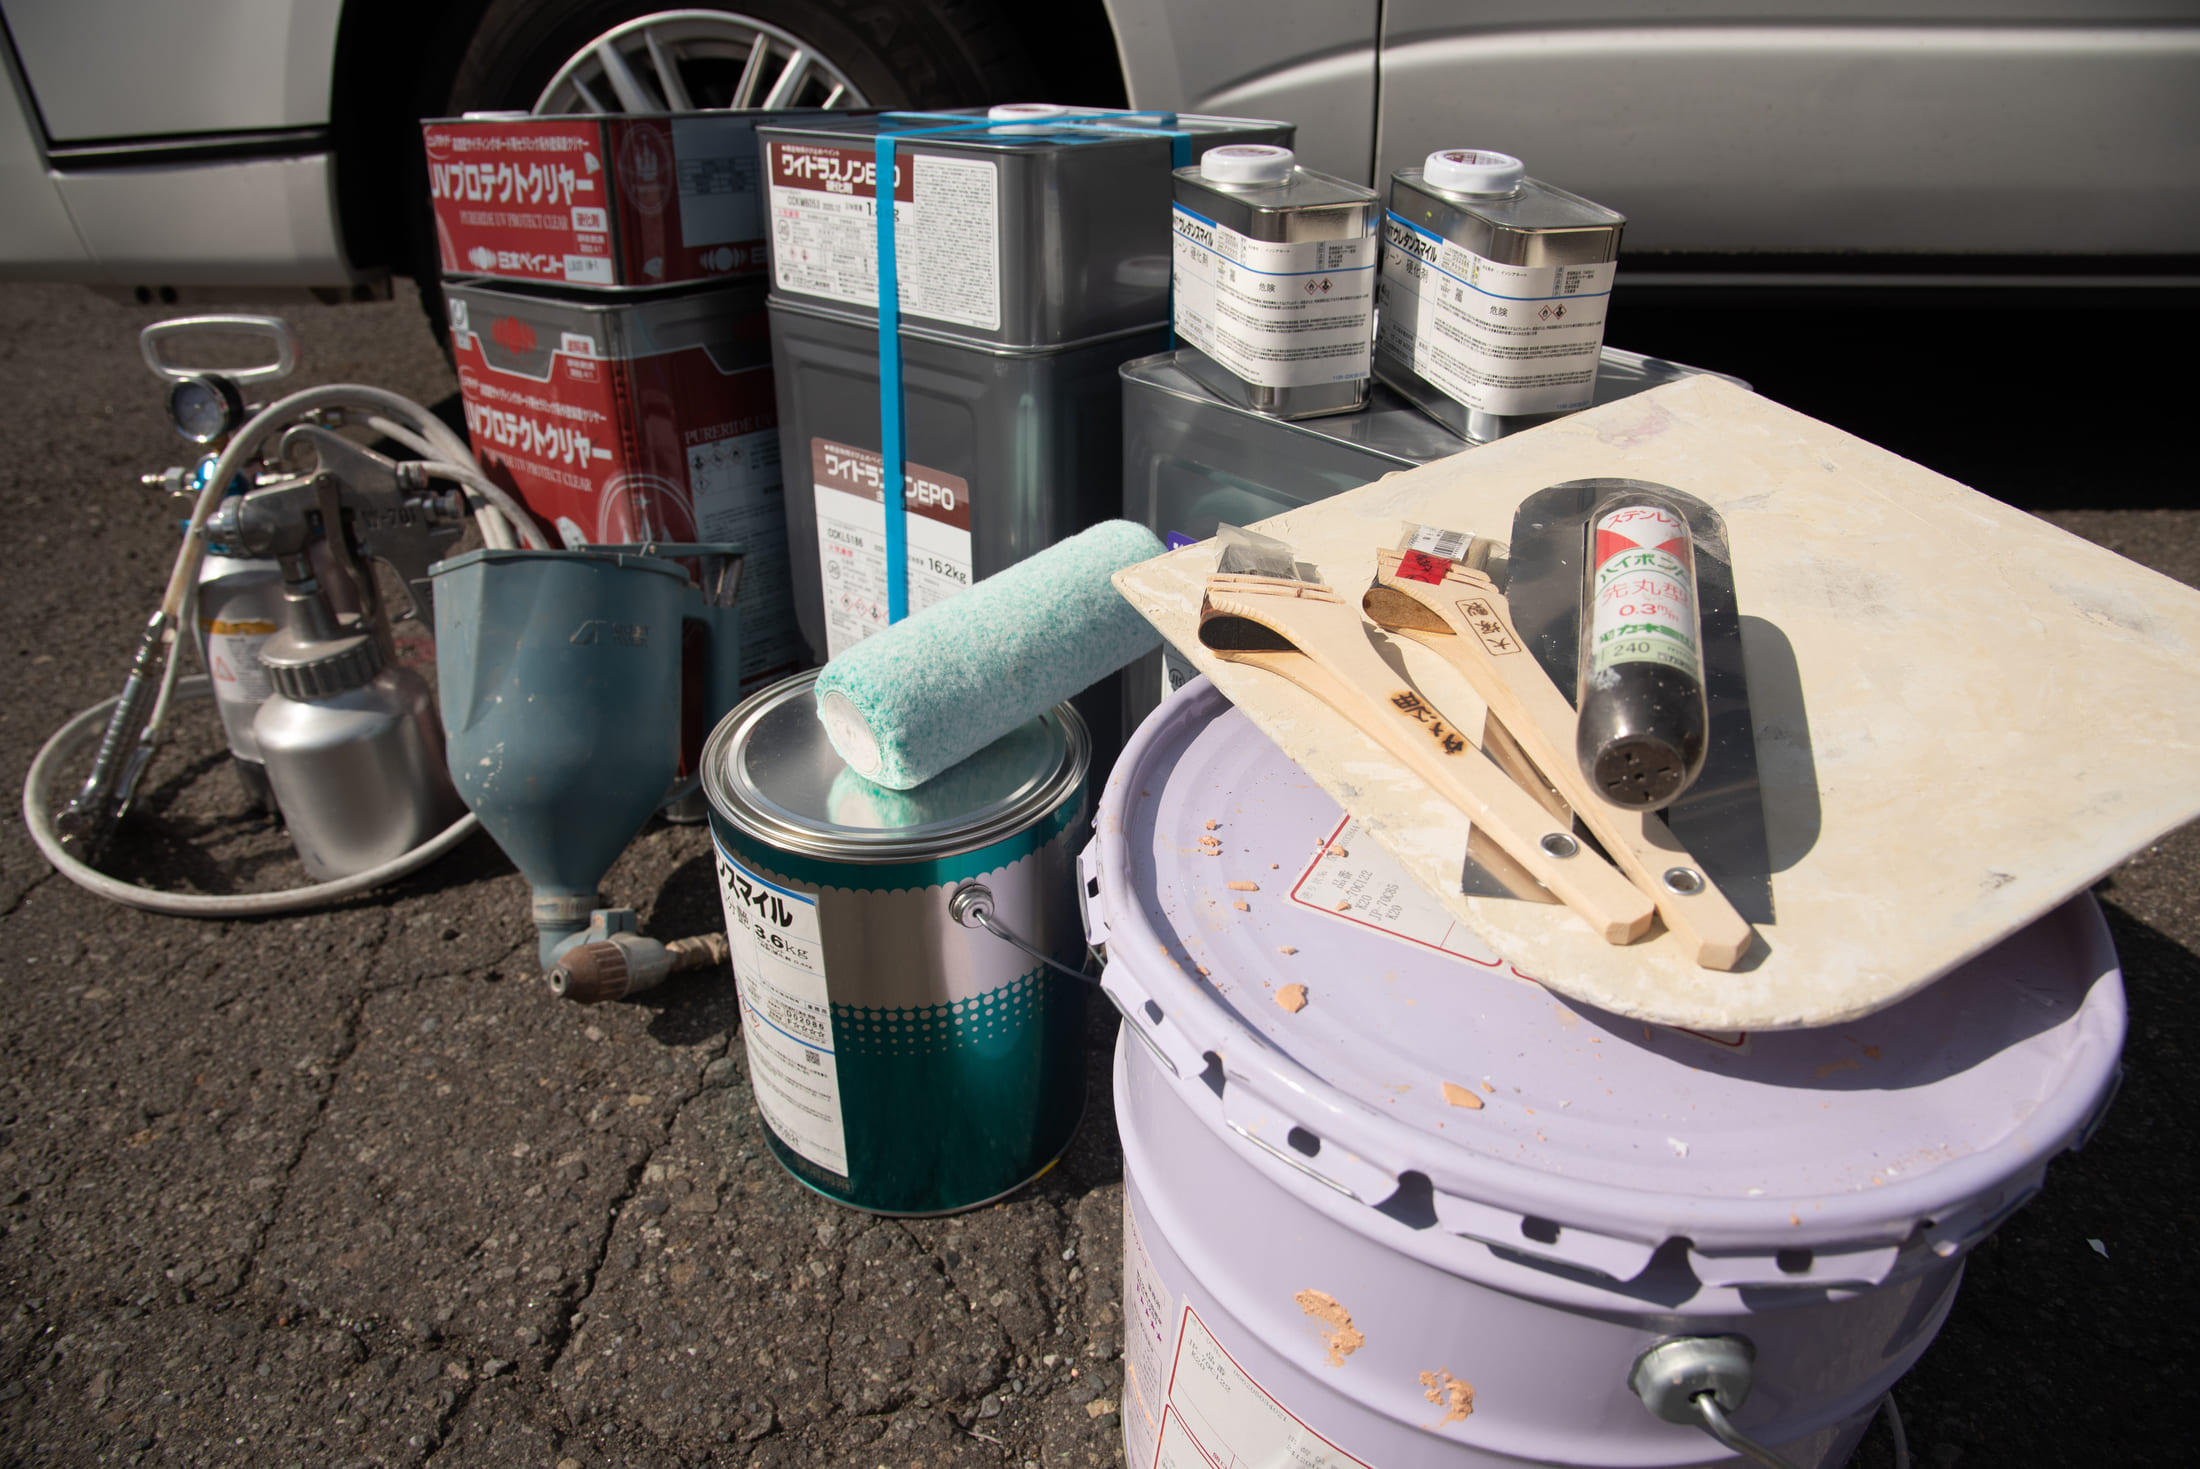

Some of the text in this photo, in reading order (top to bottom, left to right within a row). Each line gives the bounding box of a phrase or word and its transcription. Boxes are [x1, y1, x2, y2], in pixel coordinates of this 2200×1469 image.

[498, 251, 563, 274] 日本ペイント
[1406, 258, 1429, 284] 硬化剤
[1259, 282, 1276, 293] 危険
[1490, 304, 1508, 318] 危険
[1602, 578, 1688, 608] 先丸型
[1613, 641, 1650, 657] 240
[754, 924, 808, 960] 3.6kg
